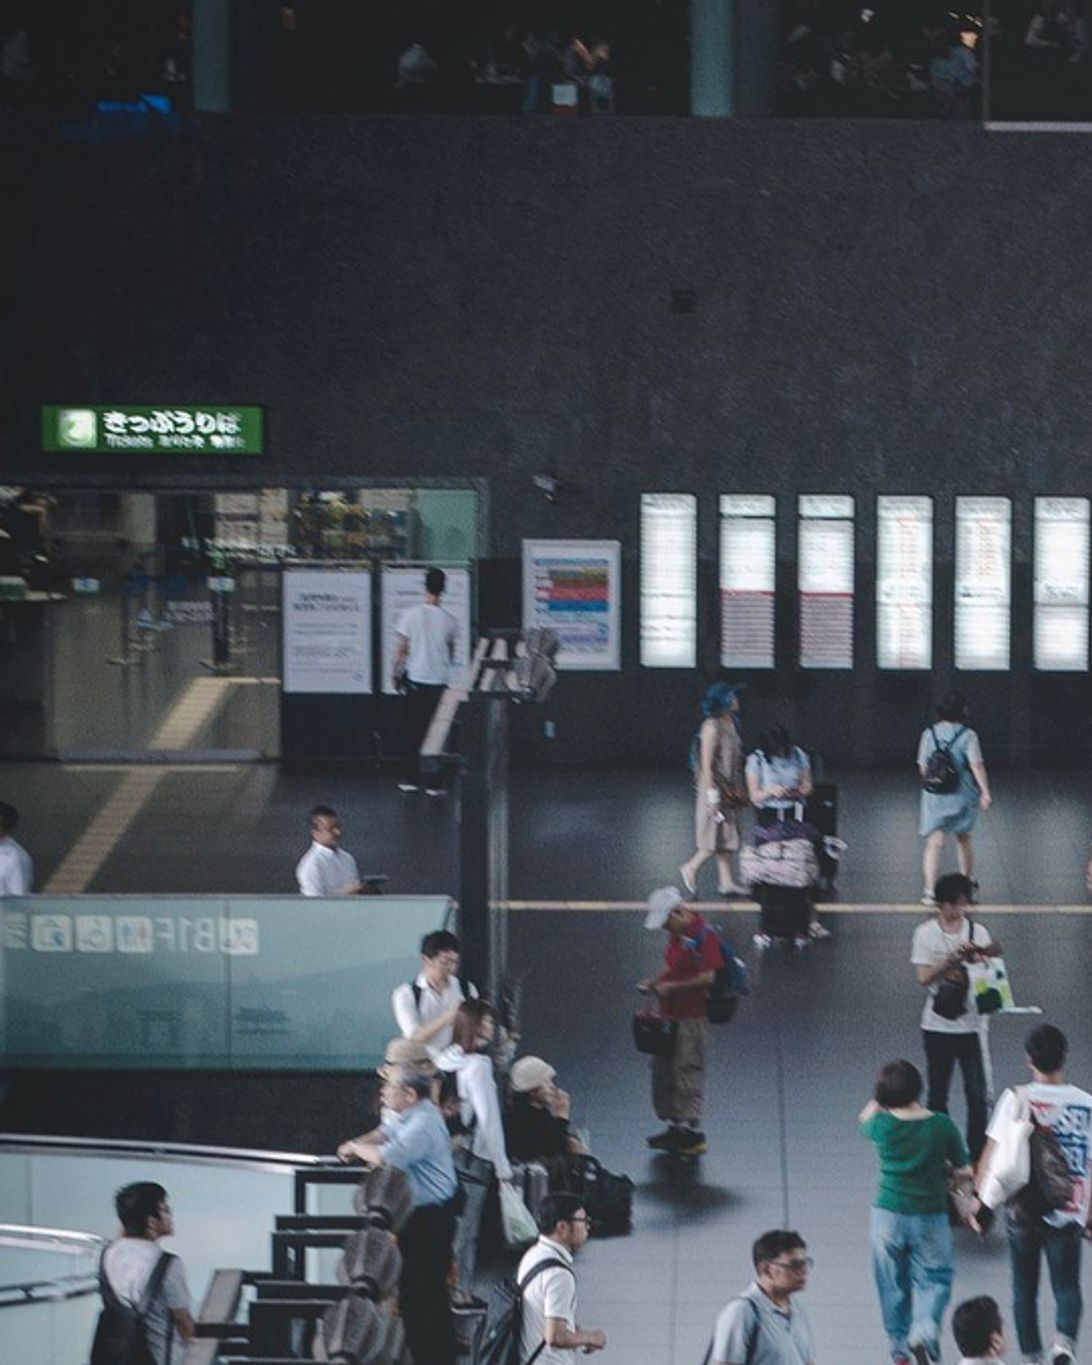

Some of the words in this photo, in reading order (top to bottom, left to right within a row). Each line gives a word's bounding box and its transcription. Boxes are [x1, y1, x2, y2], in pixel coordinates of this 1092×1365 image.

[103, 410, 242, 434] きっぷうりば
